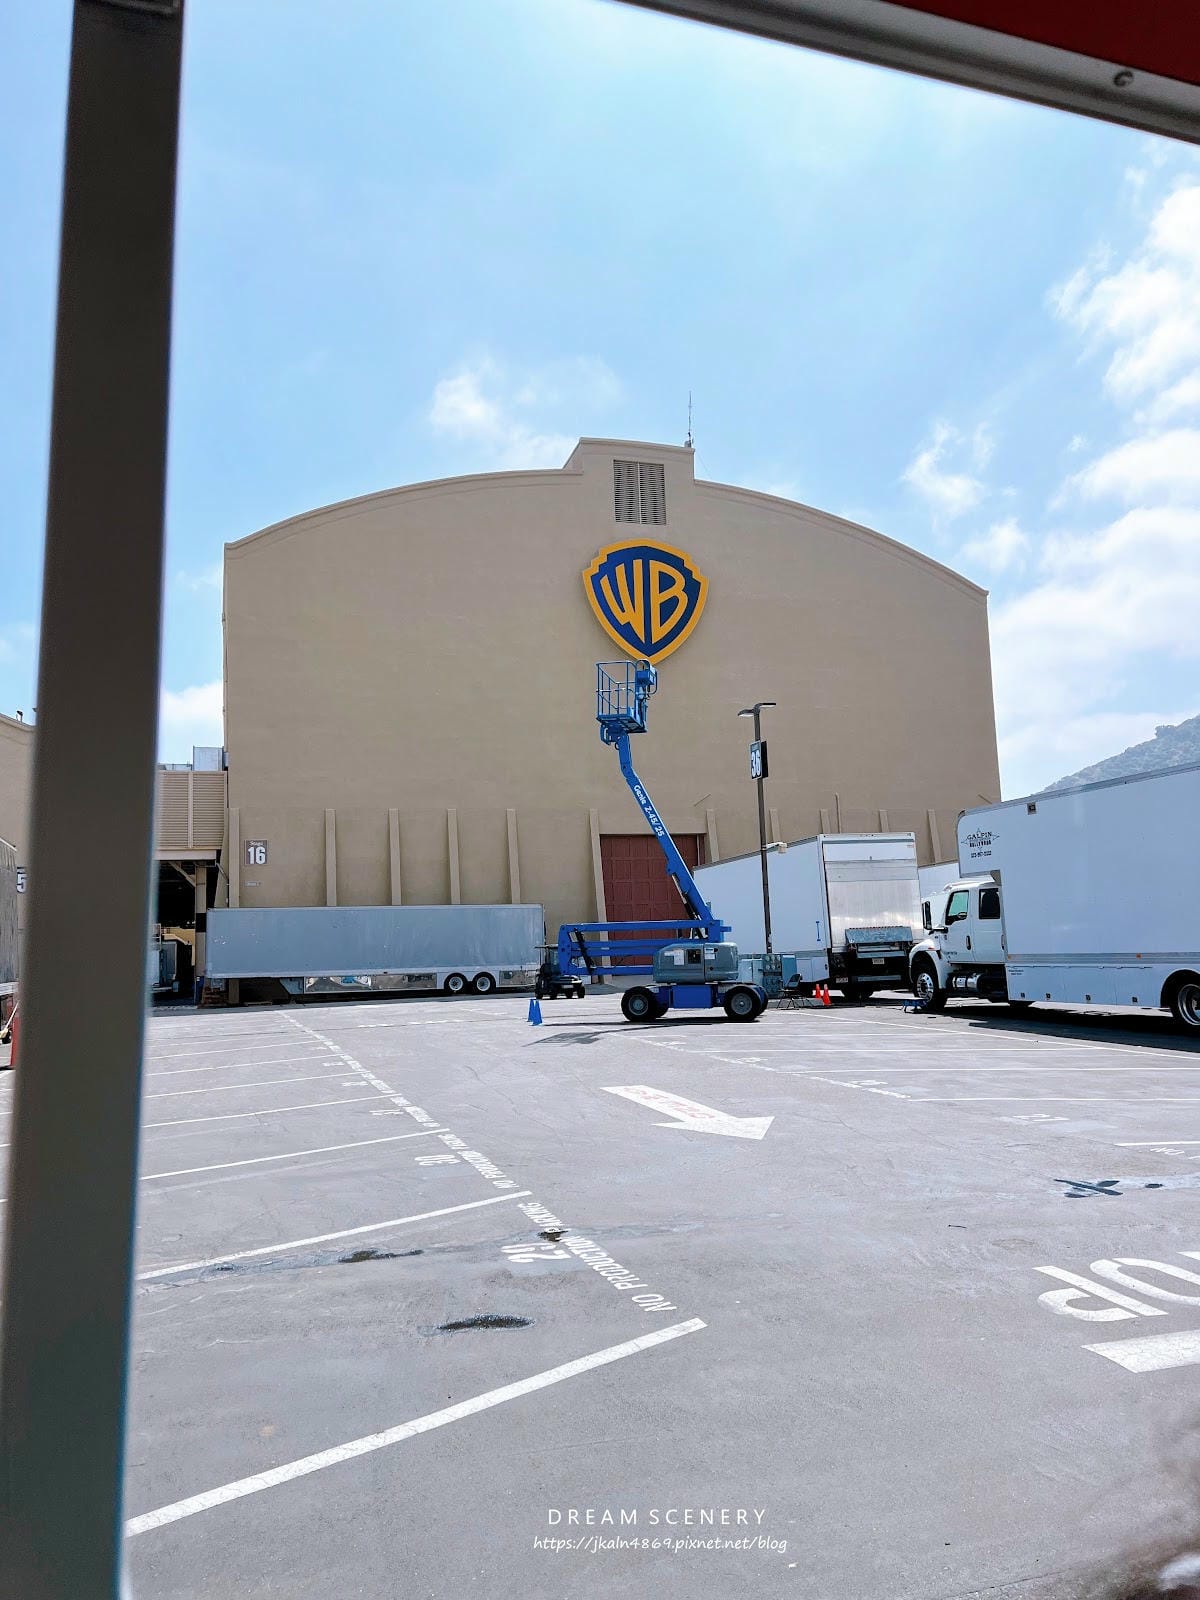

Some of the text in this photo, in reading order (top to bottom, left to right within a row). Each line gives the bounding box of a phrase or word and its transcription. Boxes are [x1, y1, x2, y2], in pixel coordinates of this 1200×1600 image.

[600, 559, 689, 645] WB
[751, 750, 761, 778] 36
[633, 784, 647, 805] Genie
[966, 831, 992, 840] GALPIN
[247, 846, 266, 865] 16
[555, 1235, 648, 1290] PRODUCTION
[1032, 1250, 1200, 1322] OP
[631, 1293, 677, 1312] NO
